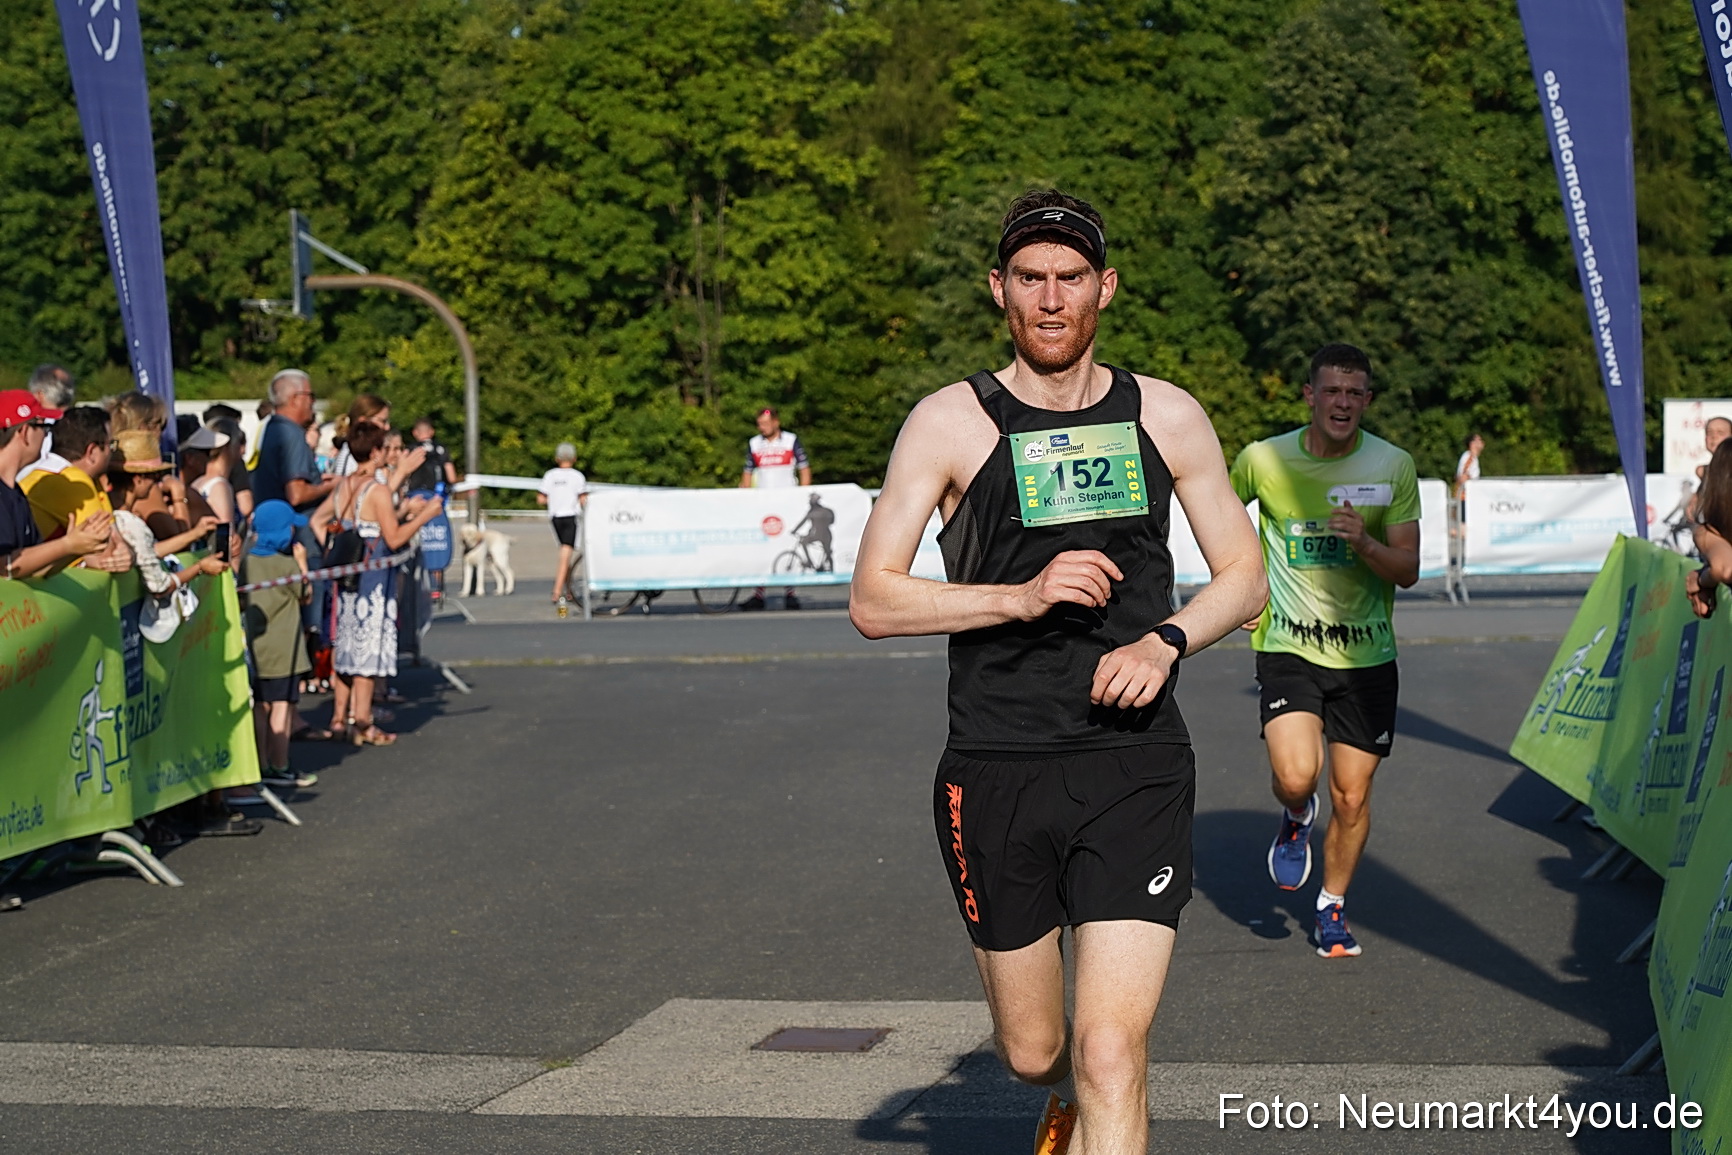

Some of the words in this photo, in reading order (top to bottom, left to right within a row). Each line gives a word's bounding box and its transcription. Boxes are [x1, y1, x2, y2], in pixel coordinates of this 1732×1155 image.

[1045, 443, 1084, 455] Firmenlauf
[1050, 457, 1114, 491] 152
[1125, 459, 1142, 502] 2022
[1024, 475, 1039, 508] RUN
[1043, 495, 1075, 507] Kuhn
[1078, 490, 1125, 505] Stephan
[1303, 536, 1338, 553] 679
